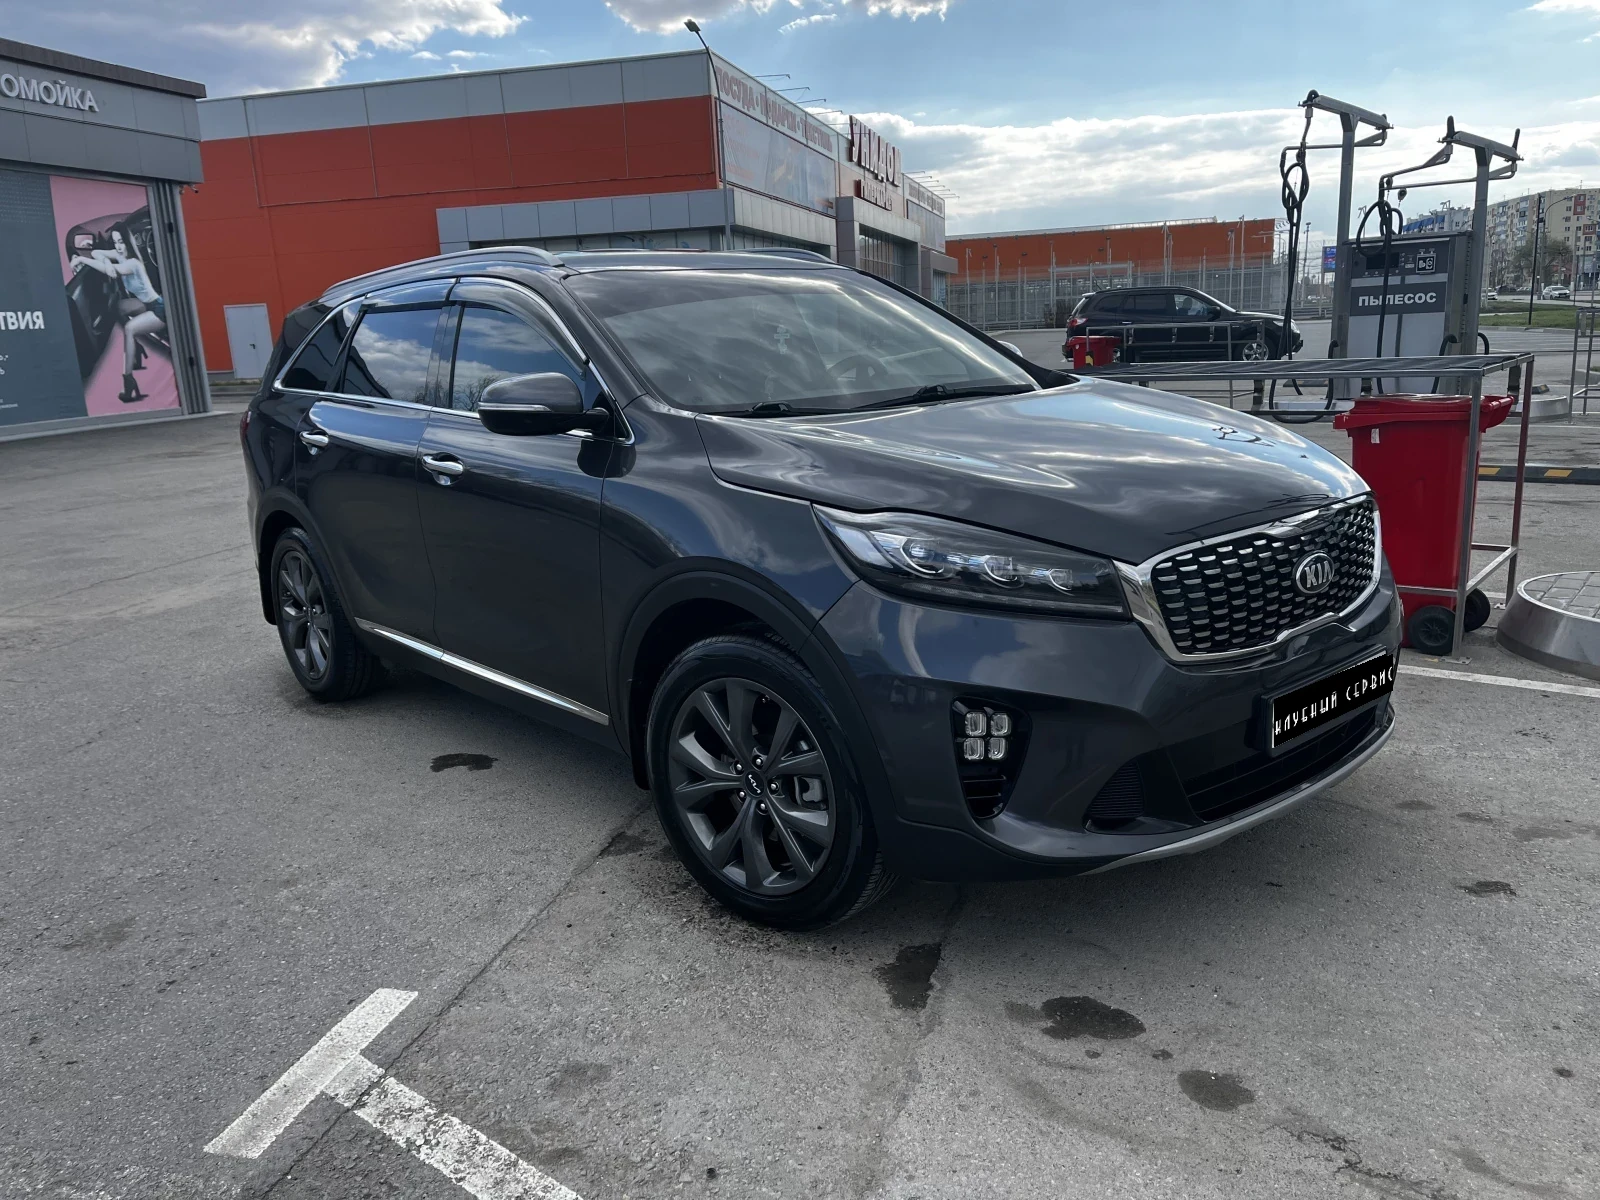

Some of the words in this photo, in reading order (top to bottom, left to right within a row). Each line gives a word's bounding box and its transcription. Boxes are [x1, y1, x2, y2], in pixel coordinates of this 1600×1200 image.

[1, 73, 100, 112] ОМОЙКА
[714, 65, 756, 112] ПОСУДА
[1358, 292, 1437, 307] ПЫЛЕСОС
[1304, 560, 1332, 588] KIA
